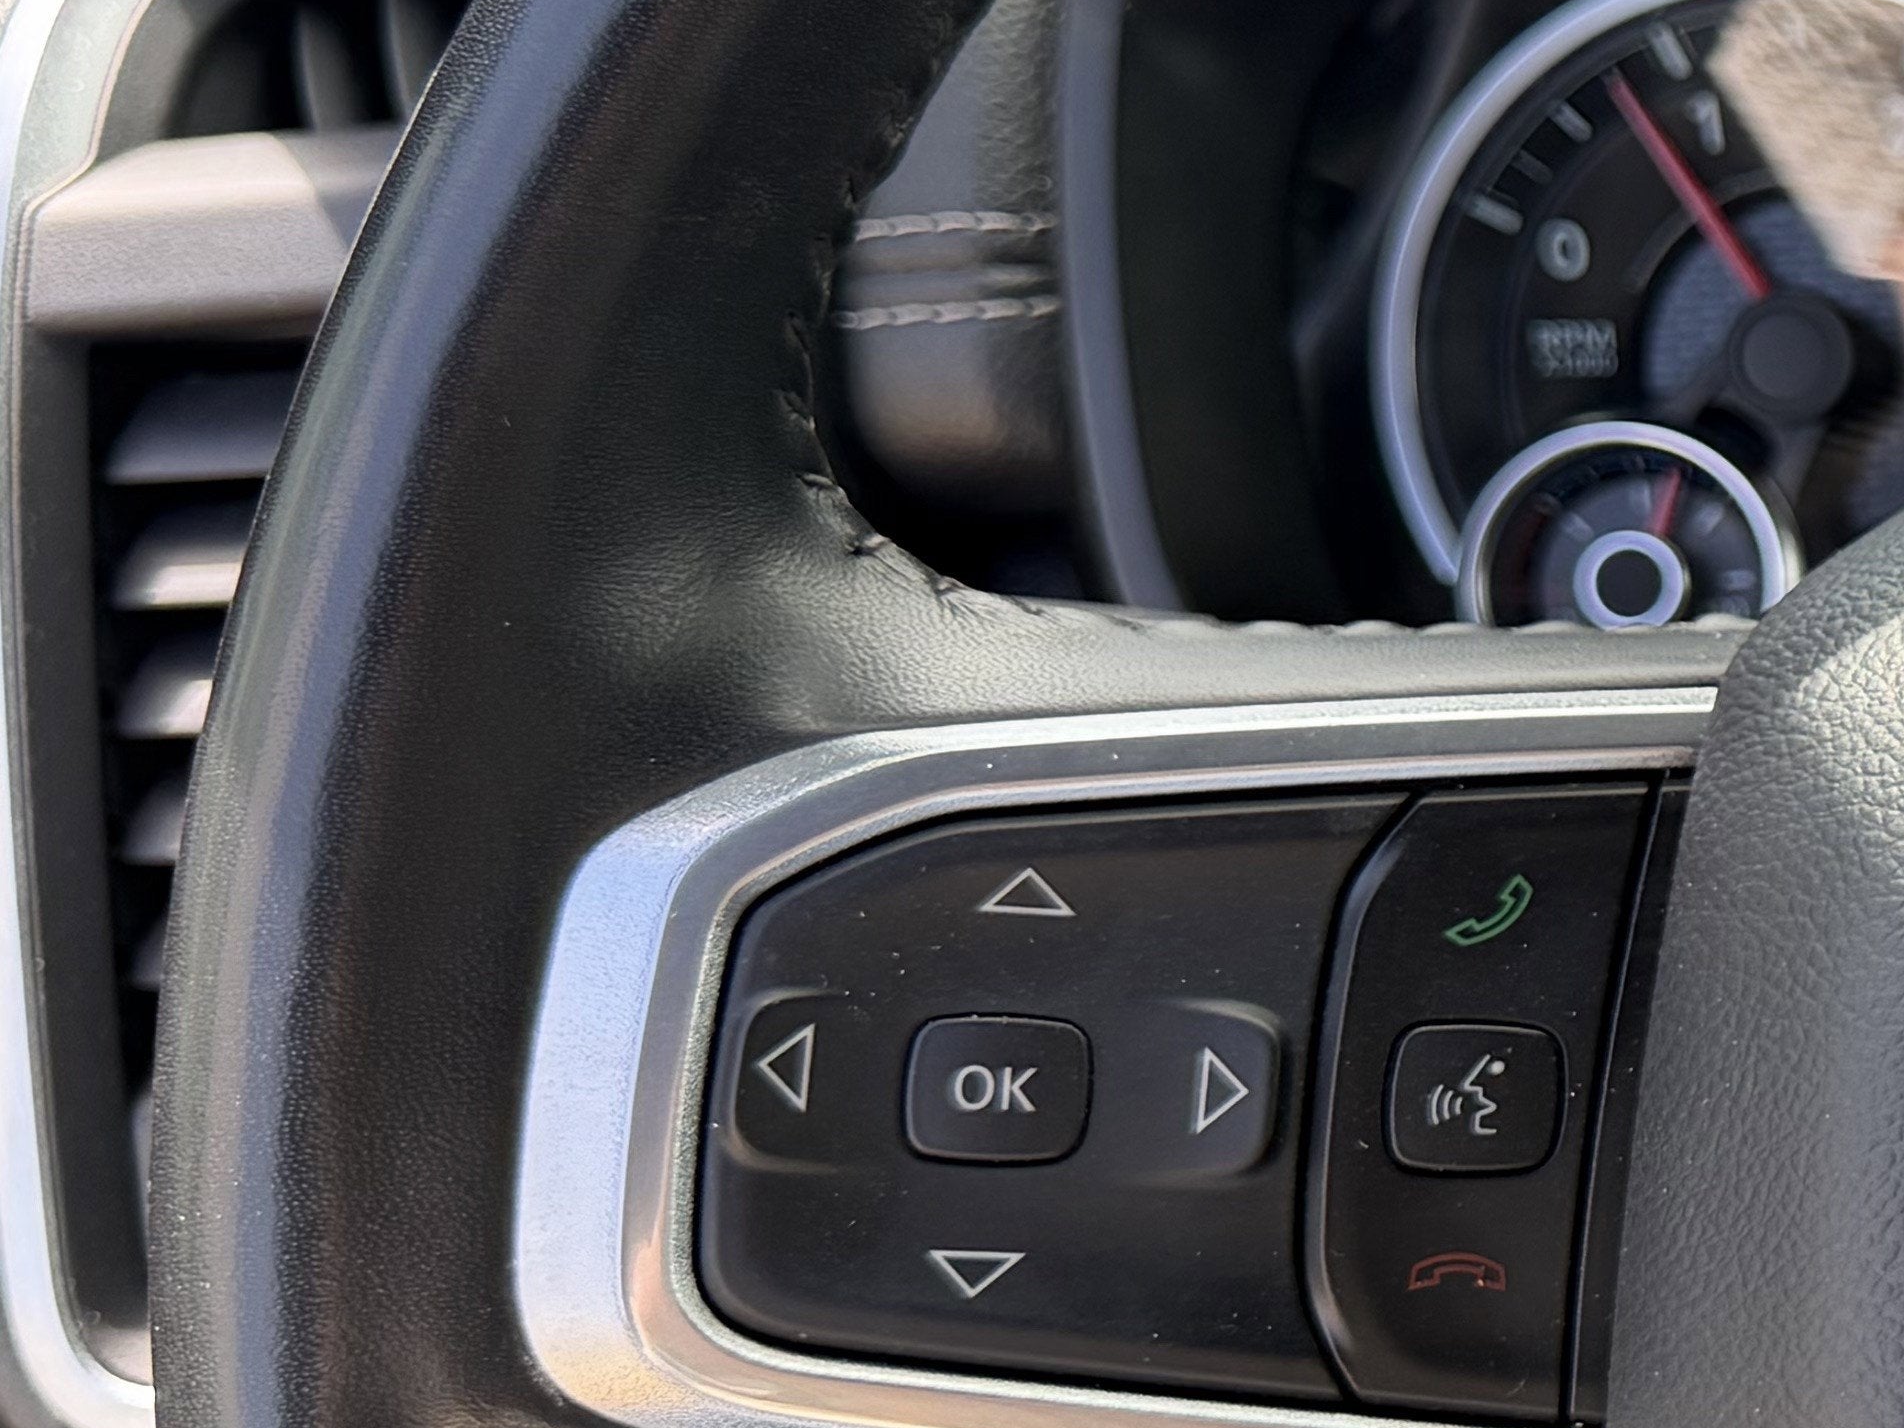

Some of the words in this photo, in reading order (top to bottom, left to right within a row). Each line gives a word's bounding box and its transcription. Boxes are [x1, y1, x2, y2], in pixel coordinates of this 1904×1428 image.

[1685, 89, 1726, 155] 1
[1536, 218, 1592, 282] 0
[952, 1062, 1038, 1117] OK
